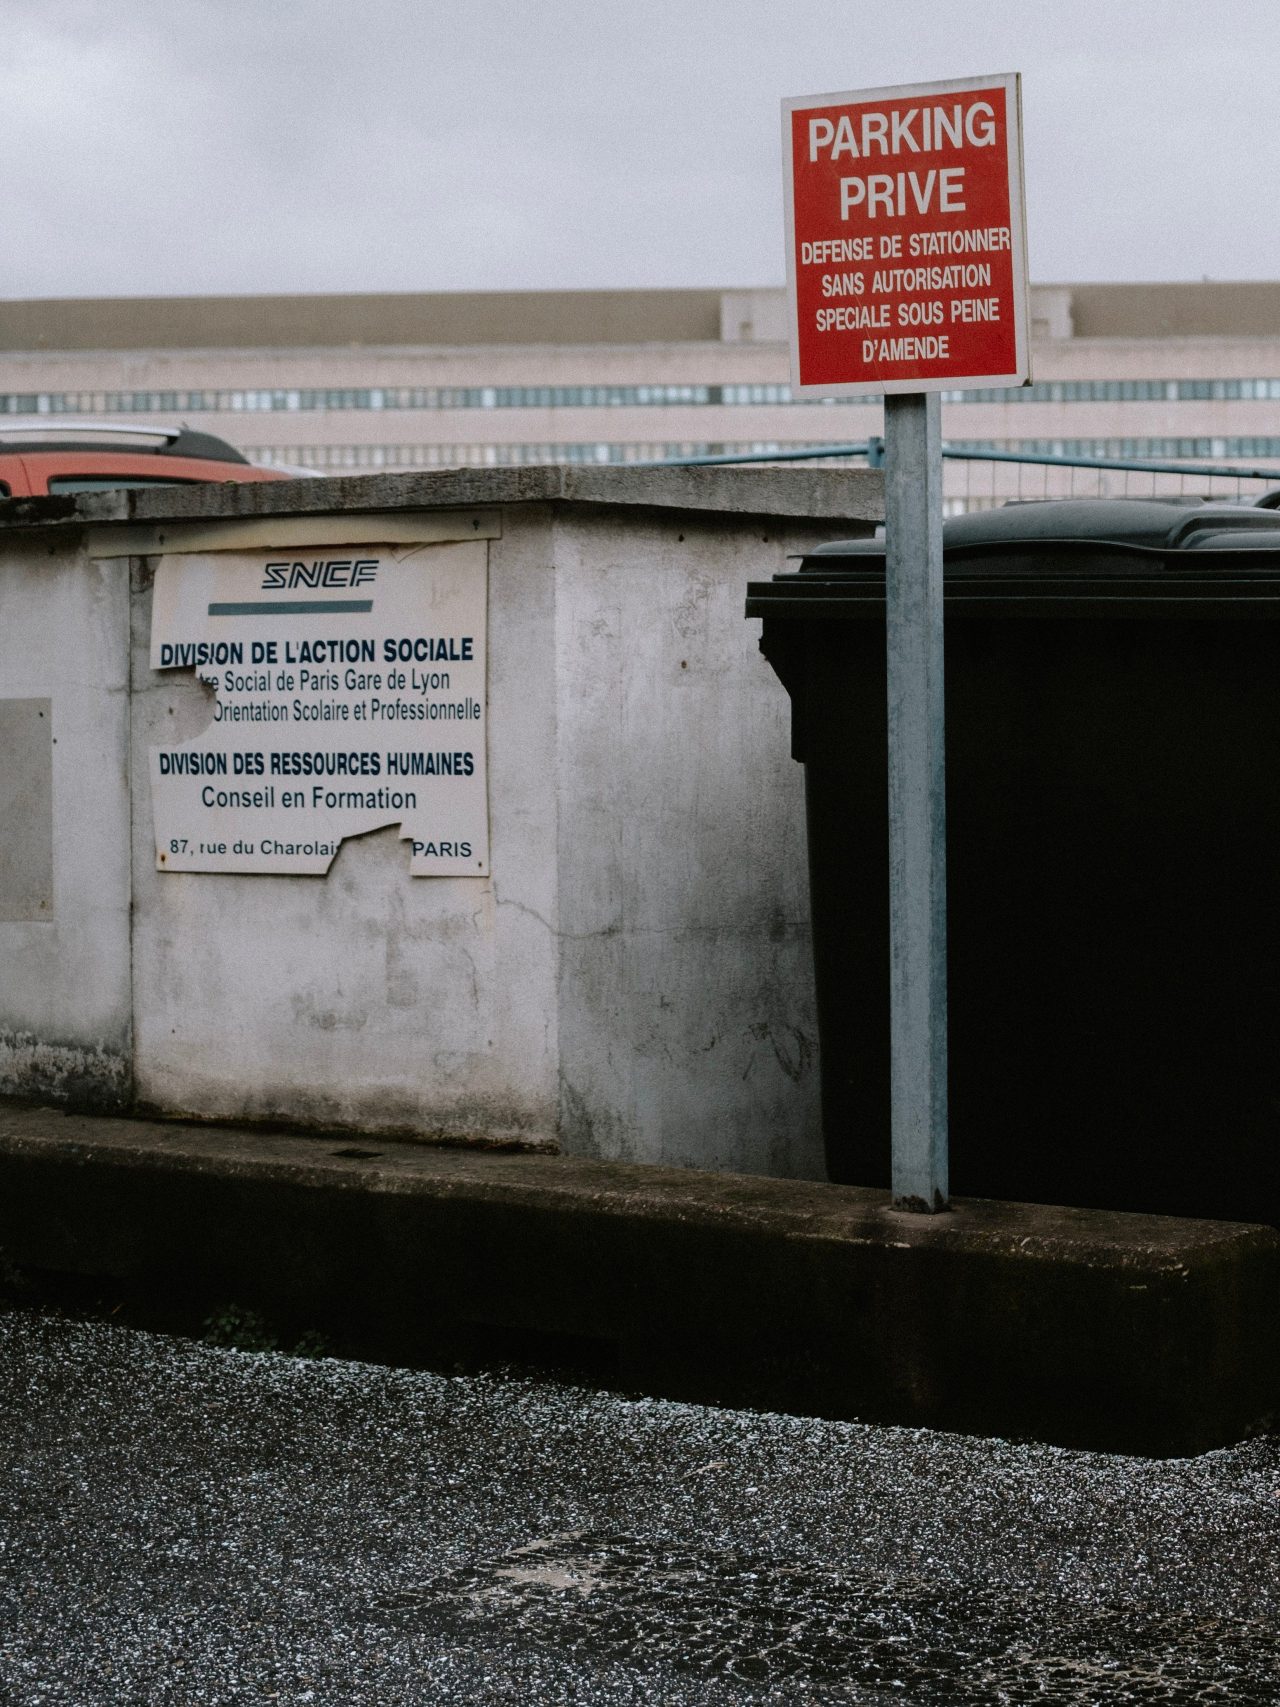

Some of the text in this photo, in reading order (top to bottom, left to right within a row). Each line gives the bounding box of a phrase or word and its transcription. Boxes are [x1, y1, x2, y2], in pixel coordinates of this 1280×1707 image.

[809, 101, 996, 162] PARKING
[841, 168, 965, 220] PRIVE
[802, 227, 1011, 264] DEFENSE DE STATIONNER
[822, 264, 990, 297] SANS AUTORISATION
[816, 298, 999, 331] SPECIALE SOUS PEINE
[863, 336, 949, 362] D'AMENDE
[262, 560, 379, 589] SNCF
[160, 638, 473, 667] DIVISION DE L'ACTION SOCIALE
[225, 671, 270, 692] Social
[277, 670, 294, 691] de
[300, 670, 339, 690] Paris
[345, 669, 381, 690] Gare
[388, 668, 405, 689] de
[412, 668, 449, 695] Lyon
[293, 699, 349, 721] Scolaire
[354, 701, 366, 720] et
[372, 698, 480, 720] Professionnelle
[159, 752, 473, 776] DIVISION DES RESSOURCES HUMAINES
[202, 786, 416, 809] Conseil en Formation
[171, 840, 193, 855] 87,
[200, 843, 226, 854] rue
[233, 840, 253, 854] du
[412, 841, 473, 858] PARIS
